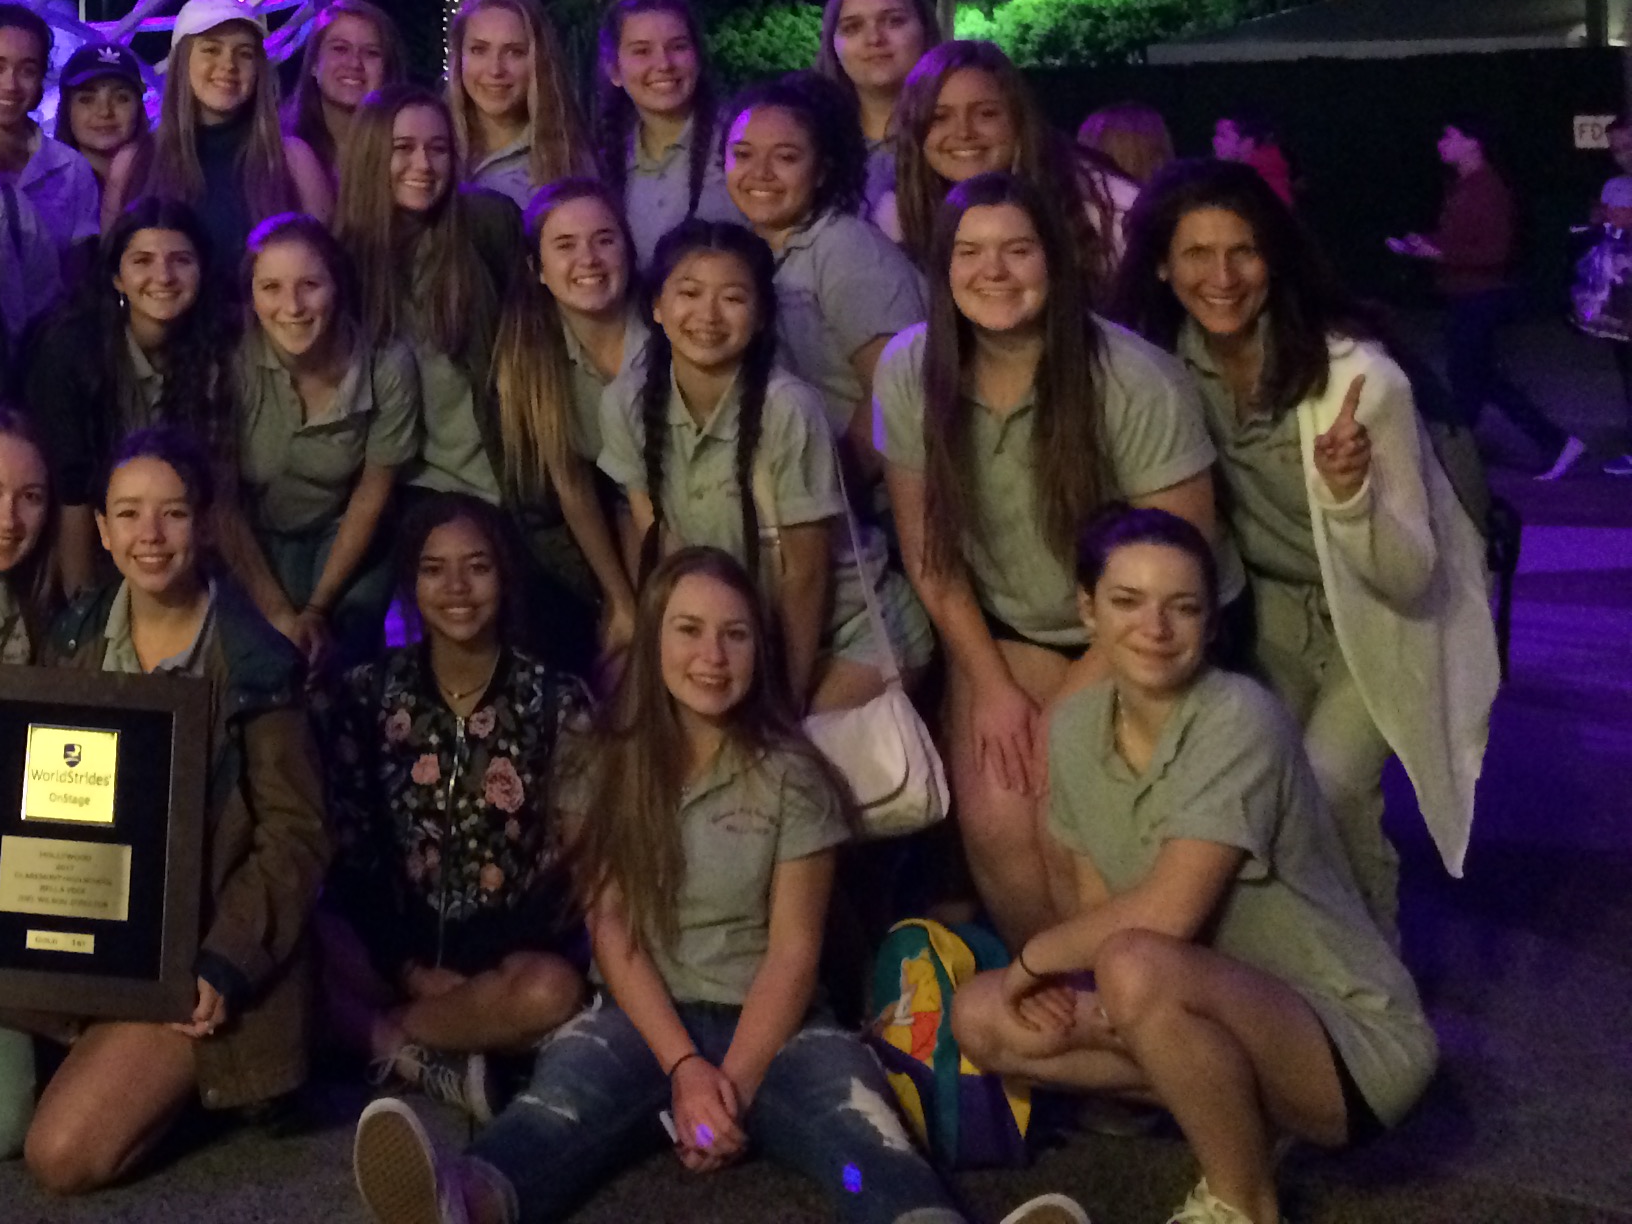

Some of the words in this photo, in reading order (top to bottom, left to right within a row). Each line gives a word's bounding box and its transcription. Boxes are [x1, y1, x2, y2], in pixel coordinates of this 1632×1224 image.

[1578, 122, 1606, 142] FD
[31, 768, 110, 787] WorldStrides
[49, 792, 91, 807] OnStage
